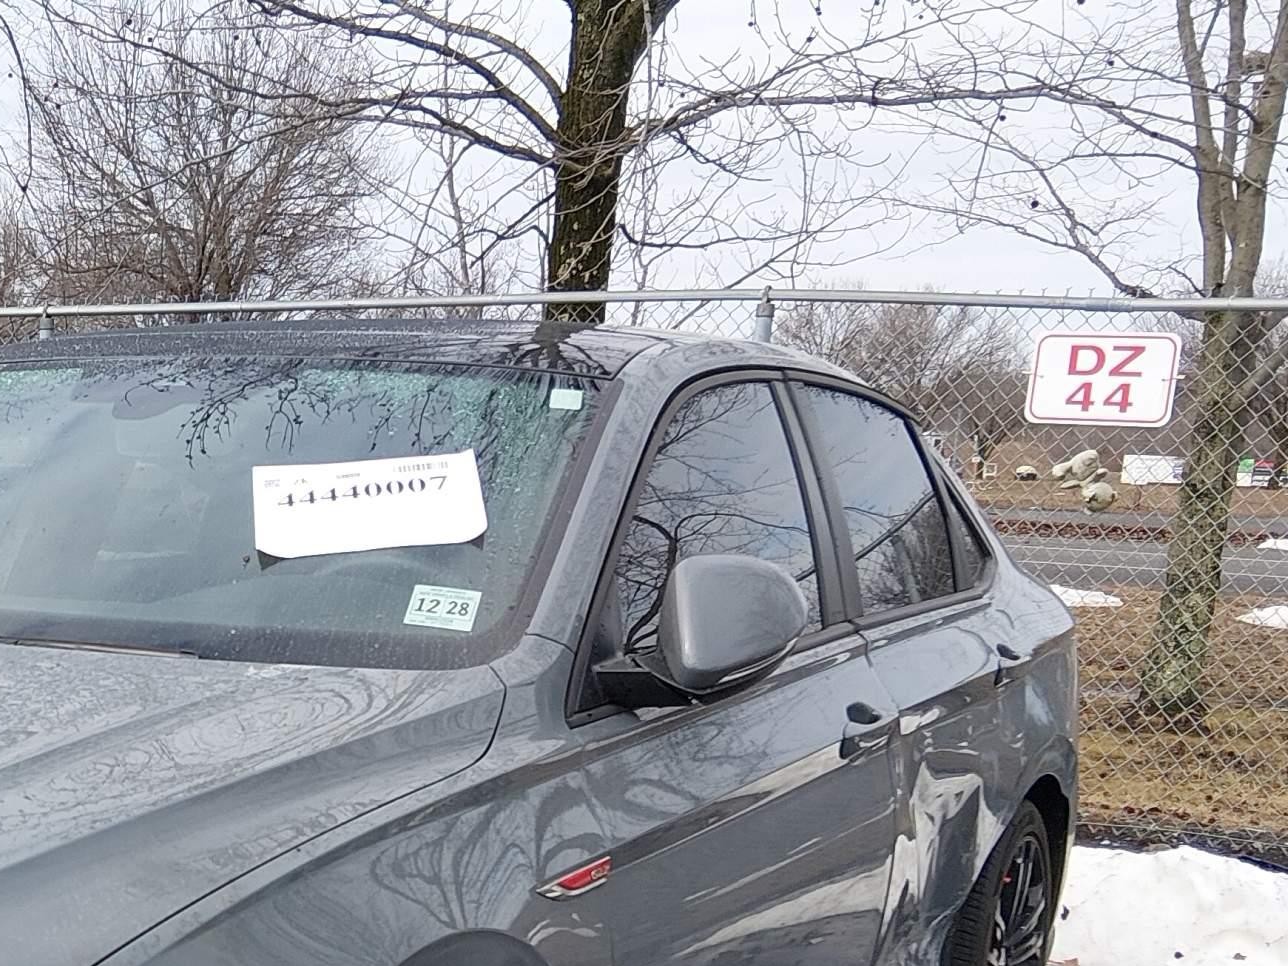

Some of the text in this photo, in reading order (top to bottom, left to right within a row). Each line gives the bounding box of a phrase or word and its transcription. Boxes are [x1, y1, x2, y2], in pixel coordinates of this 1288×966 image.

[1067, 344, 1146, 378] DZ
[1065, 382, 1134, 413] 44
[277, 475, 448, 508] 44440007
[414, 597, 470, 617] 12 28
